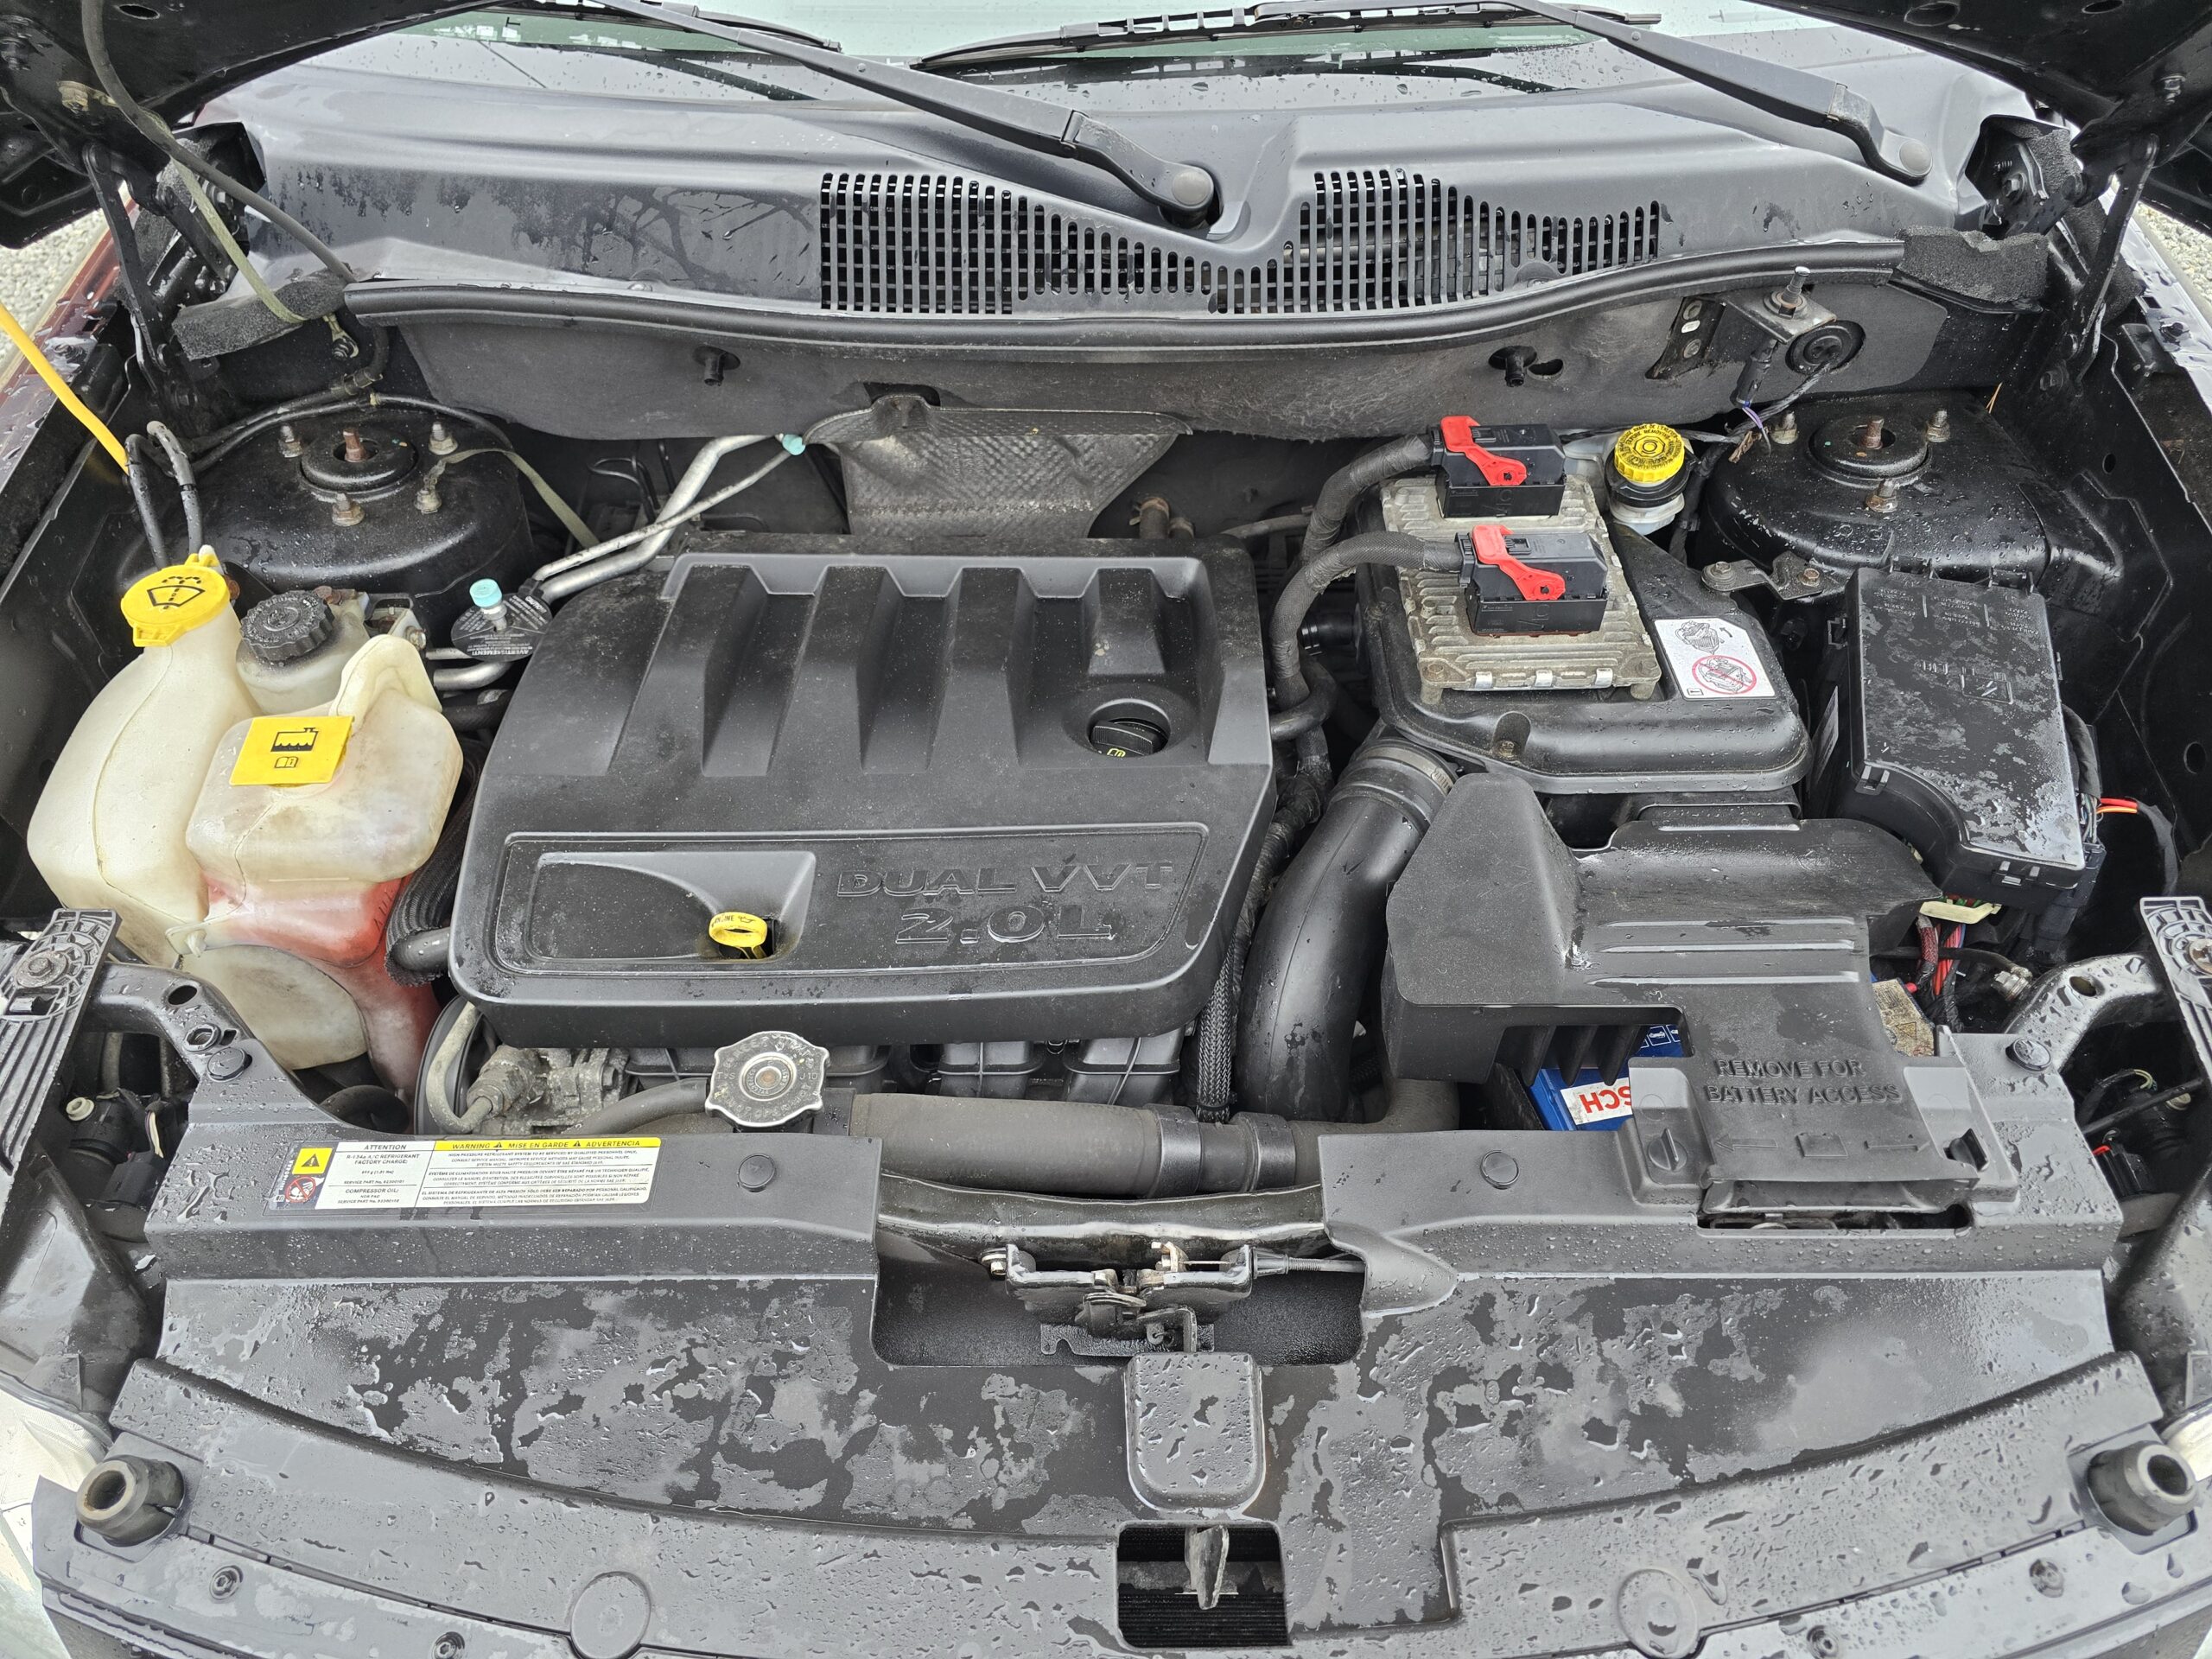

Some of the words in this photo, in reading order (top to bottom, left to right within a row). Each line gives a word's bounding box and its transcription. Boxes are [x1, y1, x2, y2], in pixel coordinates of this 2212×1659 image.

[836, 866, 1017, 897] DUAL
[1031, 863, 1173, 893] VVT
[895, 904, 1116, 944] 2.0L
[1713, 1058, 1815, 1081] REMOVE
[1816, 1058, 1865, 1077] FOR
[1579, 1085, 1631, 1114] SCH
[1703, 1084, 1802, 1106] BATTERY
[1808, 1083, 1903, 1105] ACCESS
